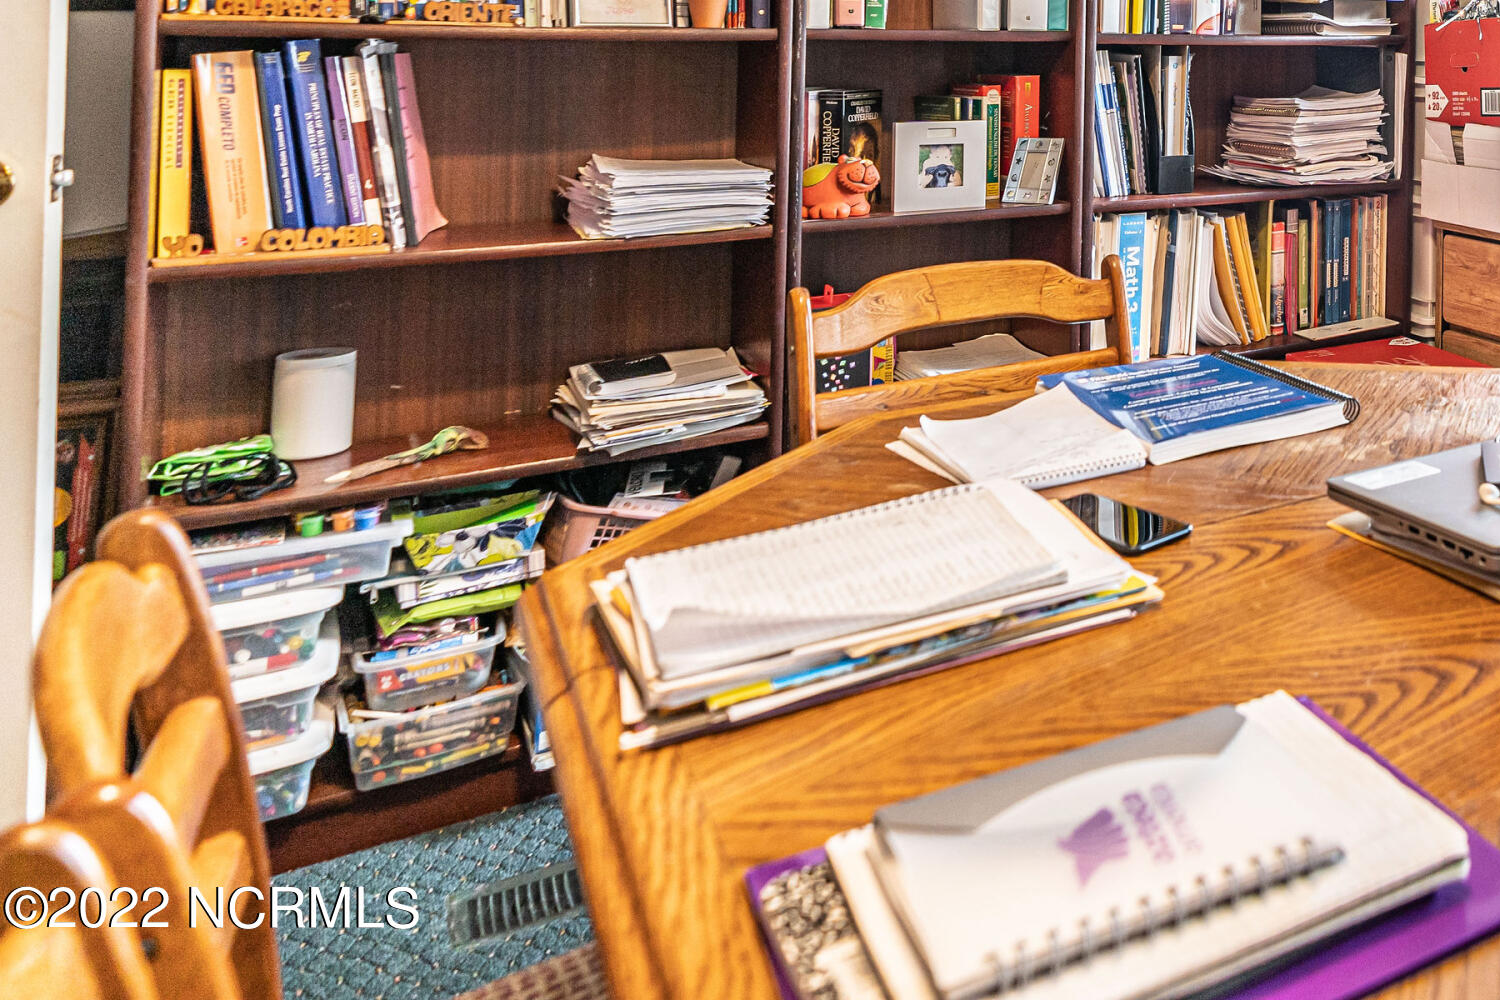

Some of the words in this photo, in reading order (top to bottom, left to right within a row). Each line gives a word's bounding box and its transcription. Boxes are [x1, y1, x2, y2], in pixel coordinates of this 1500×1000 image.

[423, 1, 518, 22] ORIENTE
[218, 96, 236, 151] COMPLETO
[847, 112, 879, 122] COPPERFIELD
[856, 105, 871, 114] DAVID
[822, 110, 833, 163] COPPERFIE
[832, 127, 841, 158] DAVID
[261, 225, 385, 253] COLOMBIA
[1125, 246, 1141, 299] Math
[1127, 302, 1139, 313] 3
